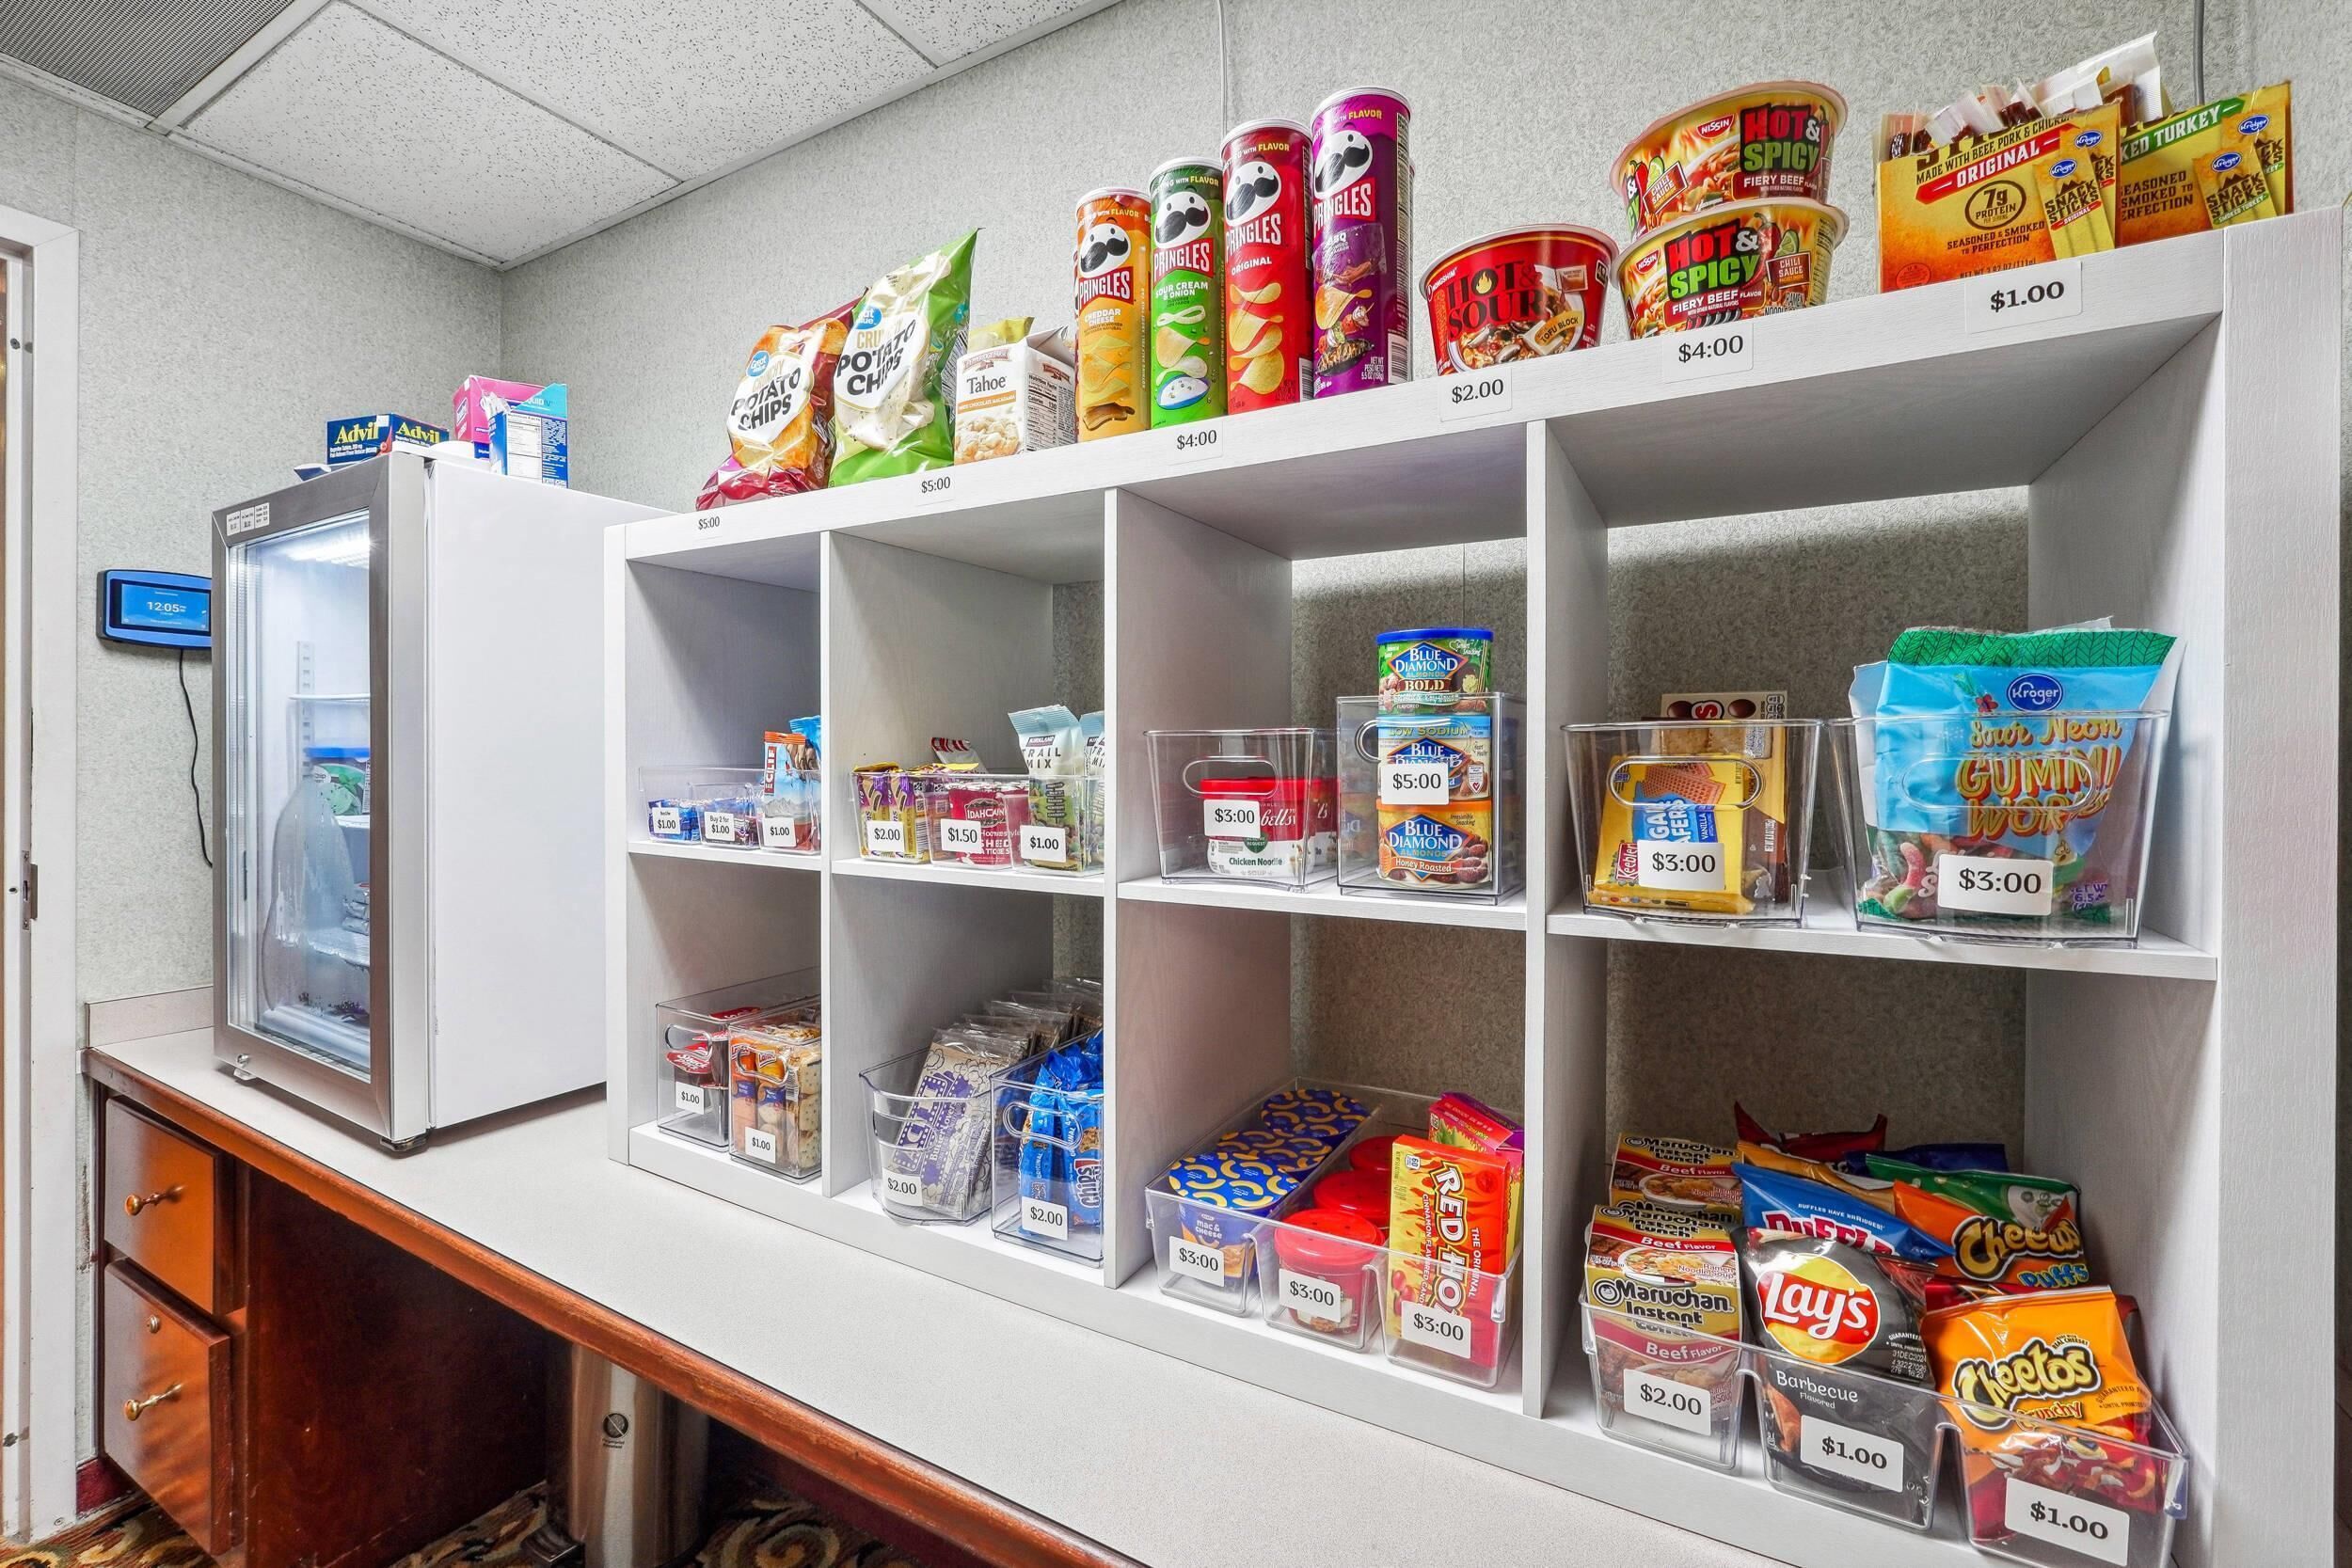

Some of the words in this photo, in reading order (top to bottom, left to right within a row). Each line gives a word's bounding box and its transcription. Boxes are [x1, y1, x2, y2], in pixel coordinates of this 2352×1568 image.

[1348, 109, 1382, 119] FLAVOR
[1701, 119, 1731, 134] NISSIN
[1744, 107, 1808, 143] HOT
[1806, 119, 1820, 142] &
[2154, 105, 2220, 147] TURKEY
[2240, 119, 2266, 131] Kroger
[1243, 147, 1256, 155] WITH
[1258, 143, 1290, 151] FLAVOR
[2076, 135, 2099, 145] Kroger
[1744, 142, 1820, 172] SPICY
[1916, 164, 1942, 185] MADE
[1946, 154, 1970, 171] WITH
[1972, 144, 1995, 160] BEEF,
[1998, 135, 2022, 149] PORK
[2024, 130, 2030, 138] &
[1957, 141, 2040, 188] ORIGINAL
[2214, 156, 2239, 168] Kroger
[2052, 163, 2074, 175] Kroger
[1190, 176, 1219, 186] FLAVOR
[1743, 175, 1777, 187] FIERY
[1780, 175, 1804, 185] BEEF
[2206, 172, 2260, 208] SNACK
[1652, 181, 1675, 204] SAUCE
[1984, 188, 2008, 208] 7g
[2045, 180, 2095, 214] SNACK
[2208, 182, 2265, 218] STICKS
[1111, 208, 1139, 217] FLAVOR
[1313, 183, 1372, 238] PRINGLES
[1976, 203, 2016, 219] PROTEIN
[2048, 190, 2099, 223] STICKS
[2063, 207, 2090, 224] ORIGINAL
[1226, 214, 1281, 263] PRINGLES
[1947, 231, 1995, 249] SEASONED
[2005, 220, 2044, 237] SMOKED
[1972, 233, 2029, 254] PERFECTION
[1669, 226, 1737, 274] HOT
[1736, 231, 1758, 251] &
[1153, 242, 1210, 286] PRINGLES
[1232, 256, 1273, 276] ORIGINAL
[1638, 255, 1658, 271] NISSIN
[1778, 267, 1804, 277] SAUCE
[1780, 258, 1801, 268] CHILI
[1671, 254, 1760, 298] SPICY
[1079, 271, 1130, 309] PRINGLES
[1155, 284, 1173, 299] SOUR
[1176, 281, 1209, 290] CREAM
[1169, 289, 1196, 298] ONION
[1990, 281, 2064, 312] $1.00
[1673, 296, 1704, 314] FIERY
[1708, 290, 1739, 303] BEEF
[1084, 308, 1121, 320] CHEDDAR
[1089, 316, 1115, 326] CHEESE
[1449, 290, 1546, 338] SOUR
[1540, 325, 1558, 343] TOFU
[1558, 317, 1579, 329] BLOCK
[836, 319, 915, 377] POTATO
[1678, 335, 1743, 363] $4:00
[847, 348, 904, 395] CHIPS
[731, 367, 801, 416] POTATO
[967, 375, 1007, 394] Tahoe
[1452, 379, 1504, 404] $2.00
[738, 393, 791, 431] CHIPS
[971, 400, 992, 408] CHOCOLATE
[335, 420, 379, 444] Advil
[396, 421, 440, 444] Advil
[1177, 430, 1217, 451] $4:00
[921, 478, 951, 494] $5:00
[698, 516, 720, 531] $5:00
[1409, 648, 1442, 661] BLUE
[1395, 657, 1458, 673] DIAMOND
[1405, 679, 1445, 690] BOLD
[2012, 682, 2059, 705] Kroger
[1389, 727, 1413, 736] LOW
[1418, 727, 1468, 736] SODIUM
[1970, 720, 2033, 748] Sour
[2040, 719, 2122, 745] Neon
[1411, 742, 1445, 757] BLUE
[1392, 773, 1441, 790] $5:00
[1956, 745, 2122, 800] GUMMI
[657, 819, 676, 830] $1.00
[1215, 808, 1255, 824] $3:00
[711, 825, 730, 834] $1.00
[770, 827, 790, 836] $1.00
[874, 828, 900, 841] $2.00
[947, 828, 977, 843] $1.50
[1405, 820, 1443, 837] BLUE
[1701, 813, 1709, 840] VANILLA
[1029, 835, 1058, 850] $1.00
[1389, 832, 1462, 850] DIAMOND
[1229, 857, 1256, 866] Chicken
[1395, 858, 1418, 869] Honey
[1419, 862, 1452, 873] Roasted
[1652, 851, 1716, 873] $3:00
[1959, 868, 2042, 894] $3:00
[681, 1091, 700, 1104] $1.00
[752, 1138, 771, 1151] $1.00
[1645, 1137, 1734, 1157] Maruchan
[1648, 1146, 1711, 1160] Instant
[1411, 1157, 1419, 1167] 60
[1655, 1153, 1705, 1164] Lunch
[1660, 1164, 1695, 1175] Beef
[887, 1178, 916, 1196] $2.00
[1422, 1194, 1432, 1235] CINNAMON
[1436, 1167, 1464, 1242] RED
[1798, 1203, 1826, 1212] RUFFLES
[1828, 1209, 1845, 1218] HAVE
[1030, 1206, 1063, 1227] $2.00
[1196, 1219, 1213, 1229] mac
[1213, 1224, 1221, 1232] &
[1623, 1208, 1724, 1230] Maruchan
[1628, 1215, 1699, 1233] Instant
[1471, 1227, 1481, 1247] THE
[1634, 1224, 1692, 1238] Lunch
[1641, 1236, 1682, 1249] Beef
[1179, 1247, 1218, 1271] $3:00
[1703, 1263, 1736, 1272] Ramen
[1678, 1265, 1709, 1275] Noodle
[1289, 1280, 1334, 1306] $3:00
[1615, 1280, 1729, 1311] Maruchan
[1626, 1302, 1703, 1323] Instant
[1765, 1272, 1870, 1339] Lay's
[1413, 1312, 1464, 1341] $3:00
[1646, 1341, 1688, 1359] Beef
[1690, 1345, 1723, 1358] Flavor
[1776, 1370, 1859, 1403] Barbecue
[1959, 1345, 2091, 1422] Cheetos
[1640, 1383, 1702, 1416] $2.00
[1800, 1391, 1836, 1410] Flavored
[2017, 1402, 2083, 1425] Crunchy
[1821, 1436, 1888, 1469] $1.00
[2030, 1501, 2108, 1539] $1.00
